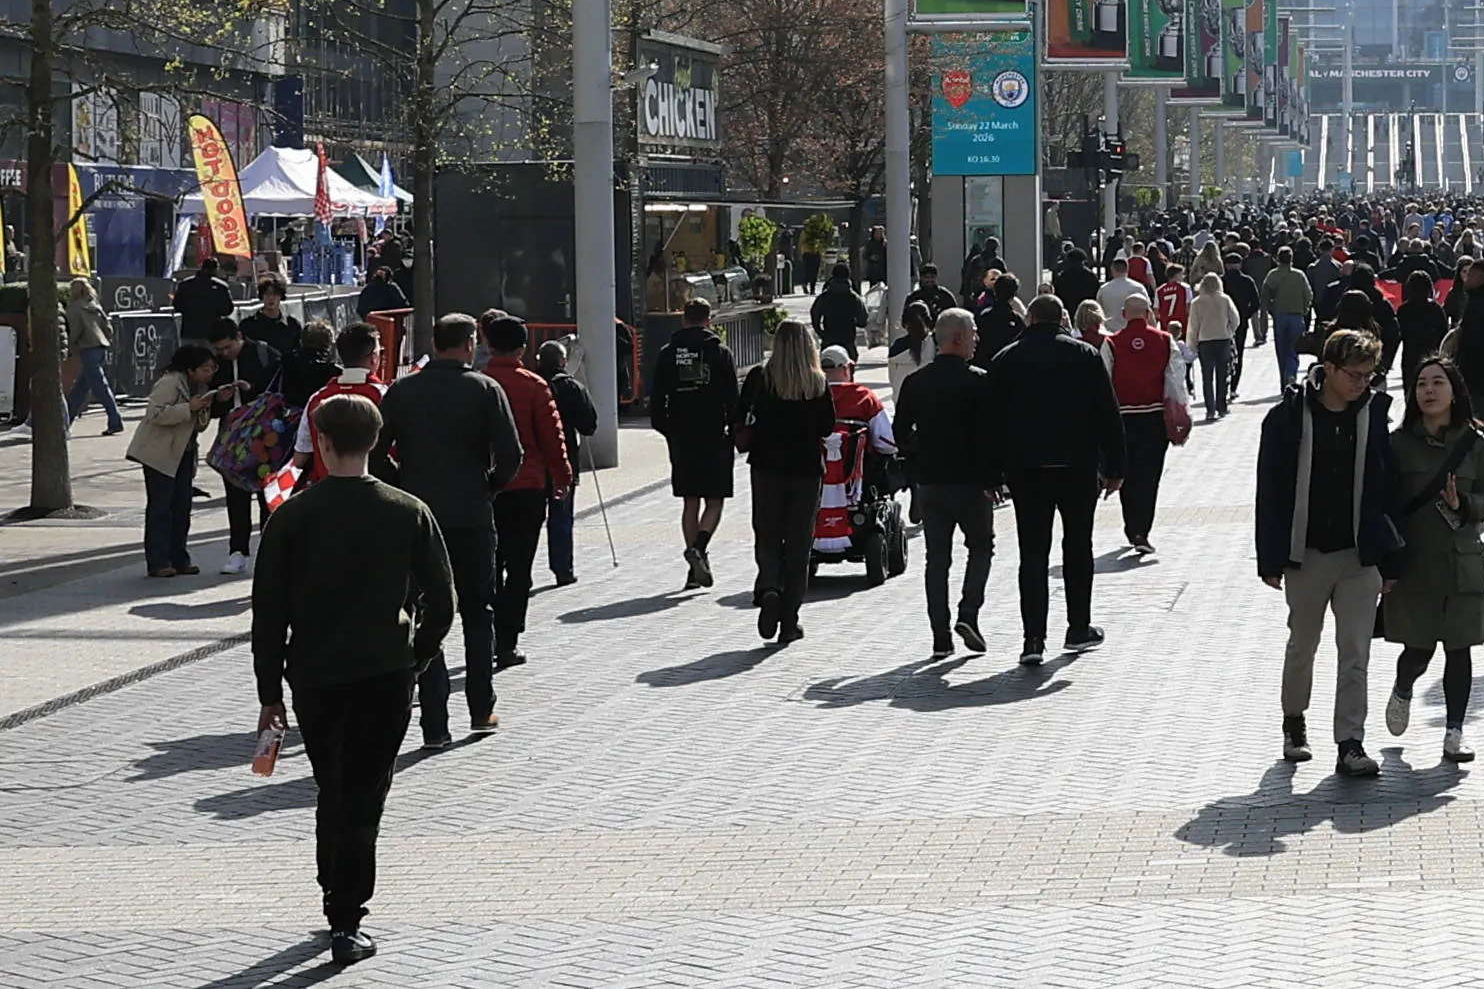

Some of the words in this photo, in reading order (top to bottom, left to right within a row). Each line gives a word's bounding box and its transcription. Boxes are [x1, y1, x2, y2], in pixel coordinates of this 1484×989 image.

[1329, 69, 1405, 78] MACHESTER
[1406, 69, 1431, 78] CITY
[645, 78, 716, 140] CHICKEN
[947, 120, 978, 132] Sunday
[978, 120, 990, 130] 22
[991, 120, 1020, 130] March
[972, 132, 995, 143] 2026
[967, 155, 979, 163] KO
[1163, 294, 1177, 317] 7
